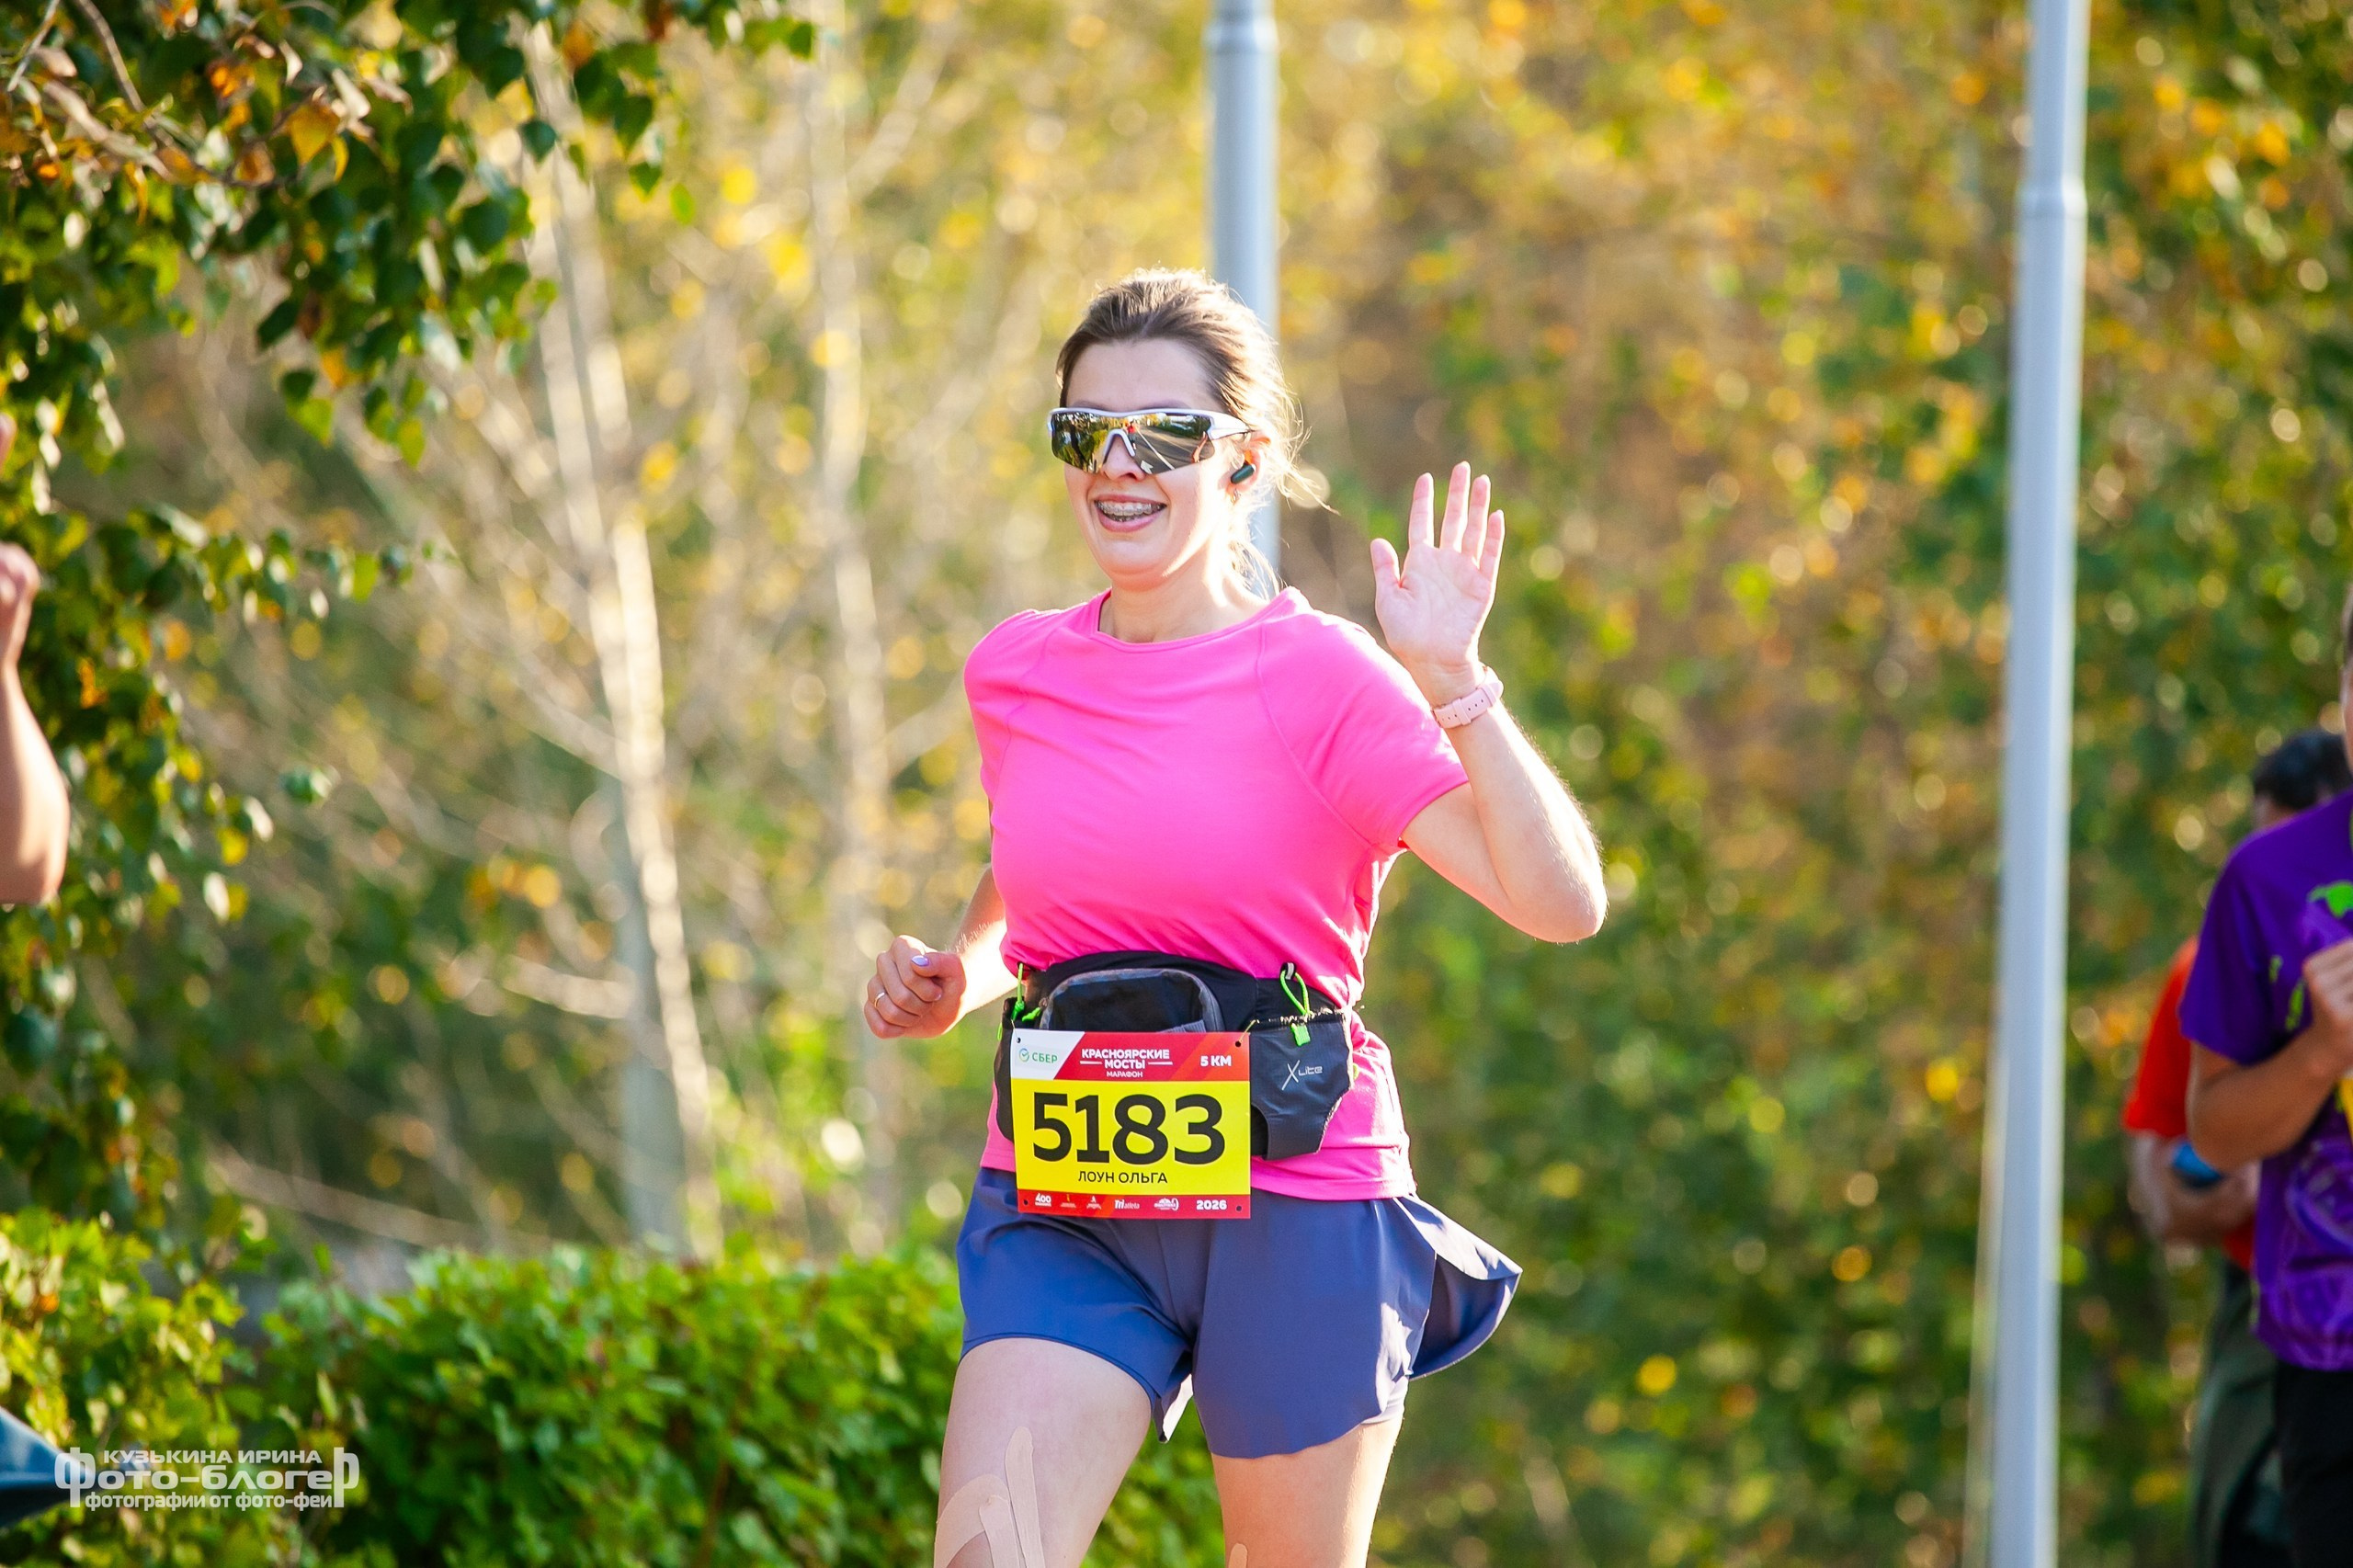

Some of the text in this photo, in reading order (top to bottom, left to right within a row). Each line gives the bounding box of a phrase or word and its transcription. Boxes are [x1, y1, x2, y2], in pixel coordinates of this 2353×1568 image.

[1032, 1053, 1058, 1063] СБЕР
[1082, 1049, 1170, 1060] КРАСНОЯРСКИЕ
[1105, 1059, 1145, 1069] МОСТЫ
[1200, 1056, 1232, 1066] 5 КМ
[1033, 1092, 1225, 1165] 5183
[1078, 1171, 1167, 1184] ЛОУН ОЛЬГА
[1035, 1193, 1051, 1203] 400
[1196, 1199, 1227, 1210] 2026
